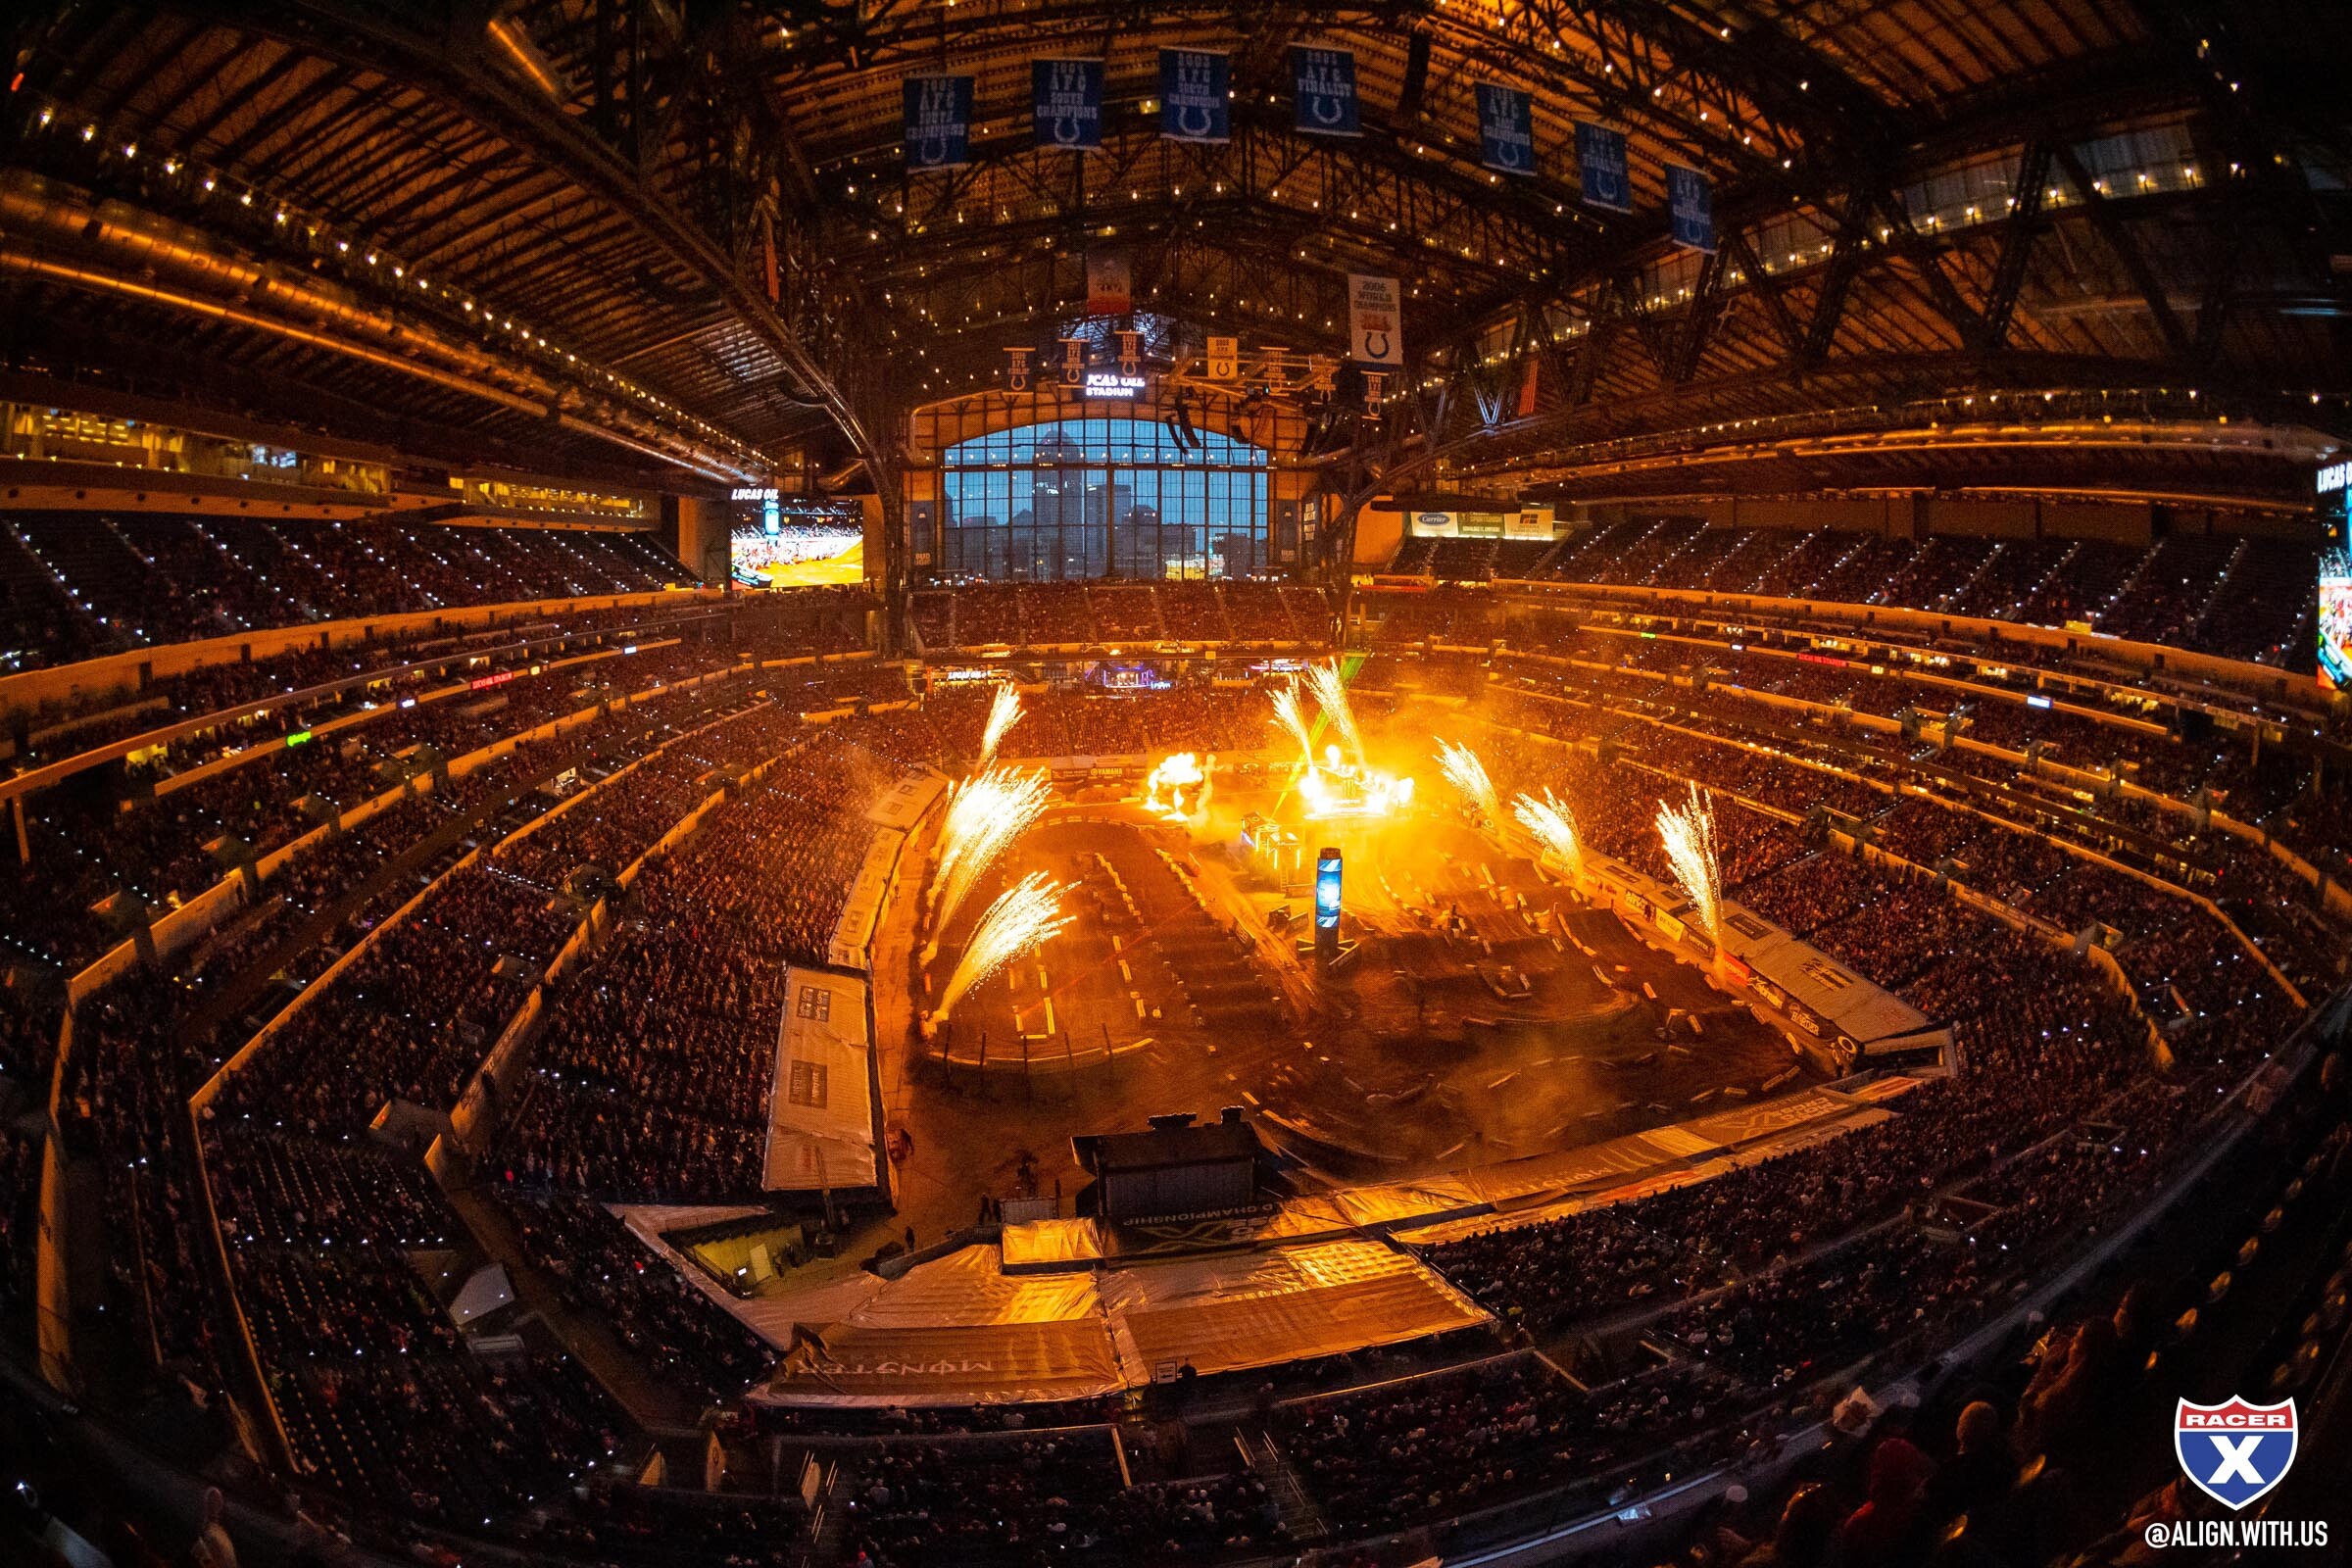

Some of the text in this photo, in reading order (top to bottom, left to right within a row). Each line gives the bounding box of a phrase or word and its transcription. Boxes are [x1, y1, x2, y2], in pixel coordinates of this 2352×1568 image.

[1086, 386, 1134, 397] STADIUM
[731, 488, 779, 501] LUCAS OIL
[1421, 514, 1447, 524] Carrier
[1122, 1204, 1257, 1226] CHAMPIONSHIP
